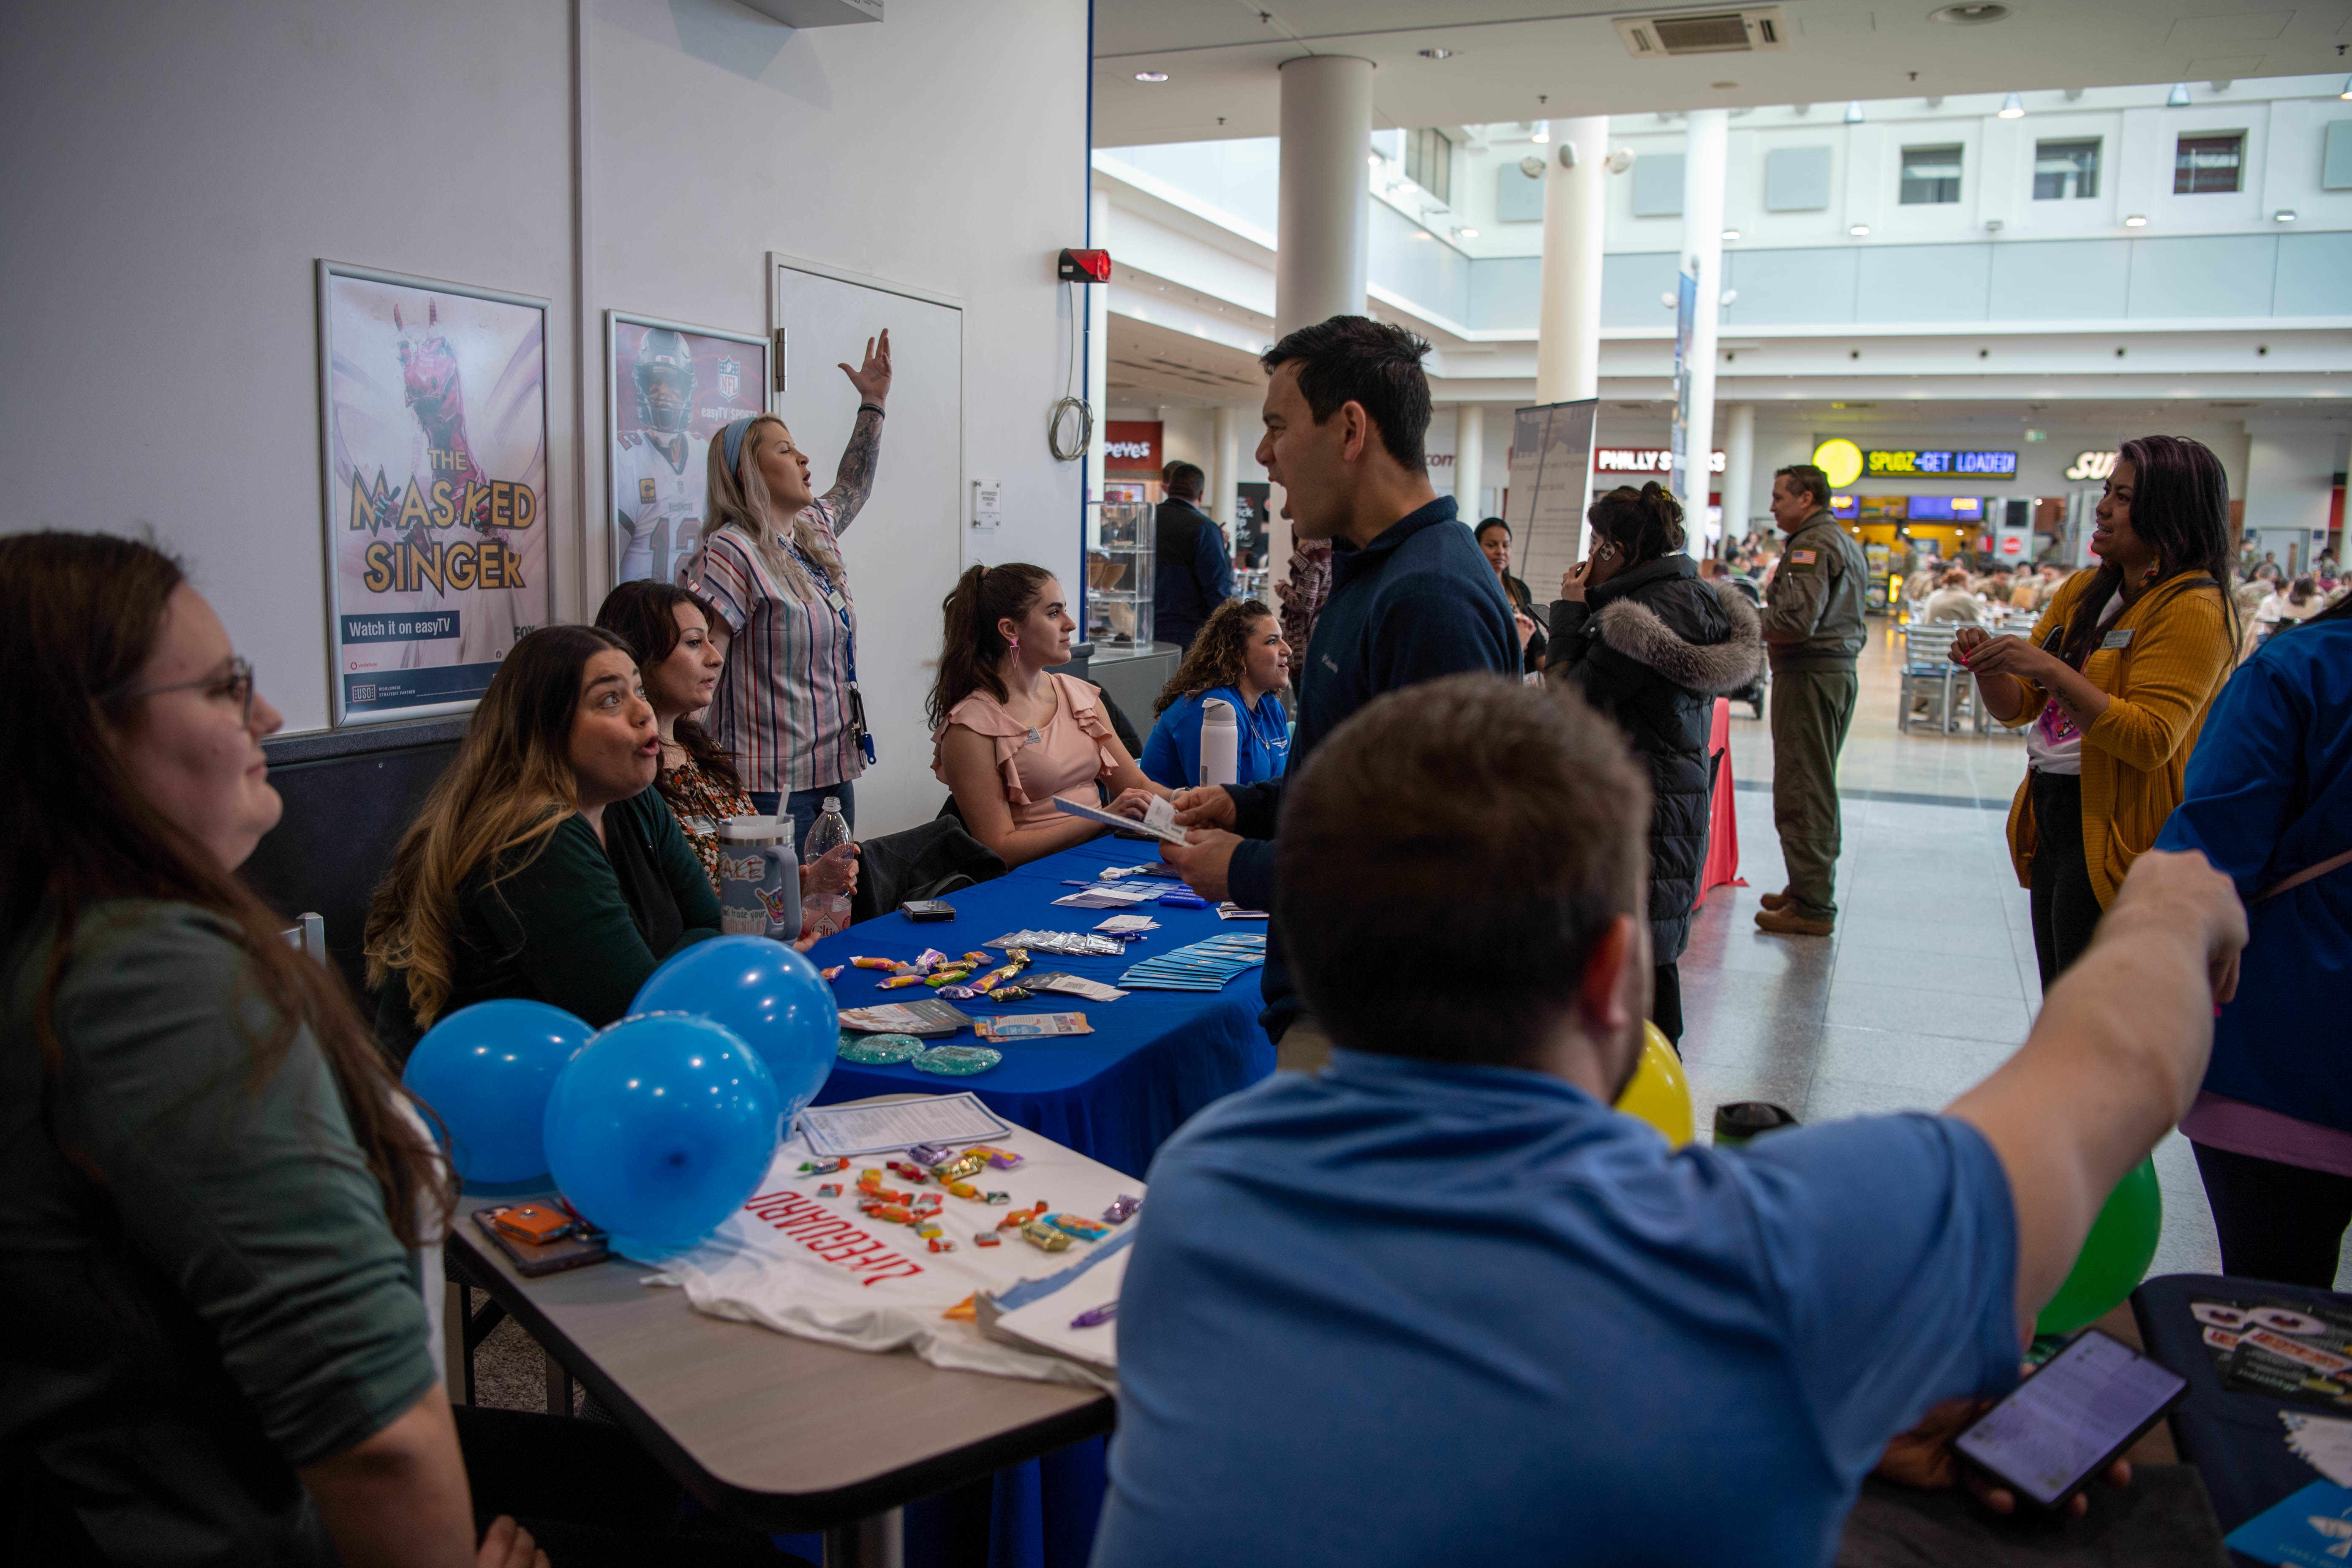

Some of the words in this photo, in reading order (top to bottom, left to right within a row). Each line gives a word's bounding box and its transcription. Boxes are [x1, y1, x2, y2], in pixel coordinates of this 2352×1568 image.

[721, 375, 737, 395] NFL
[702, 407, 728, 421] easyTV
[731, 408, 758, 420] SPORTS
[427, 449, 468, 471] THE
[1599, 450, 1658, 471] PHILLY
[350, 465, 537, 537] MASKED
[363, 537, 526, 599] SINGER
[349, 621, 385, 637] Watch
[389, 621, 395, 635] it
[399, 623, 412, 634] on
[415, 618, 450, 636] easyTV
[357, 687, 371, 700] USO
[750, 910, 766, 922] your
[744, 1191, 925, 1287] LIFEGUARD
